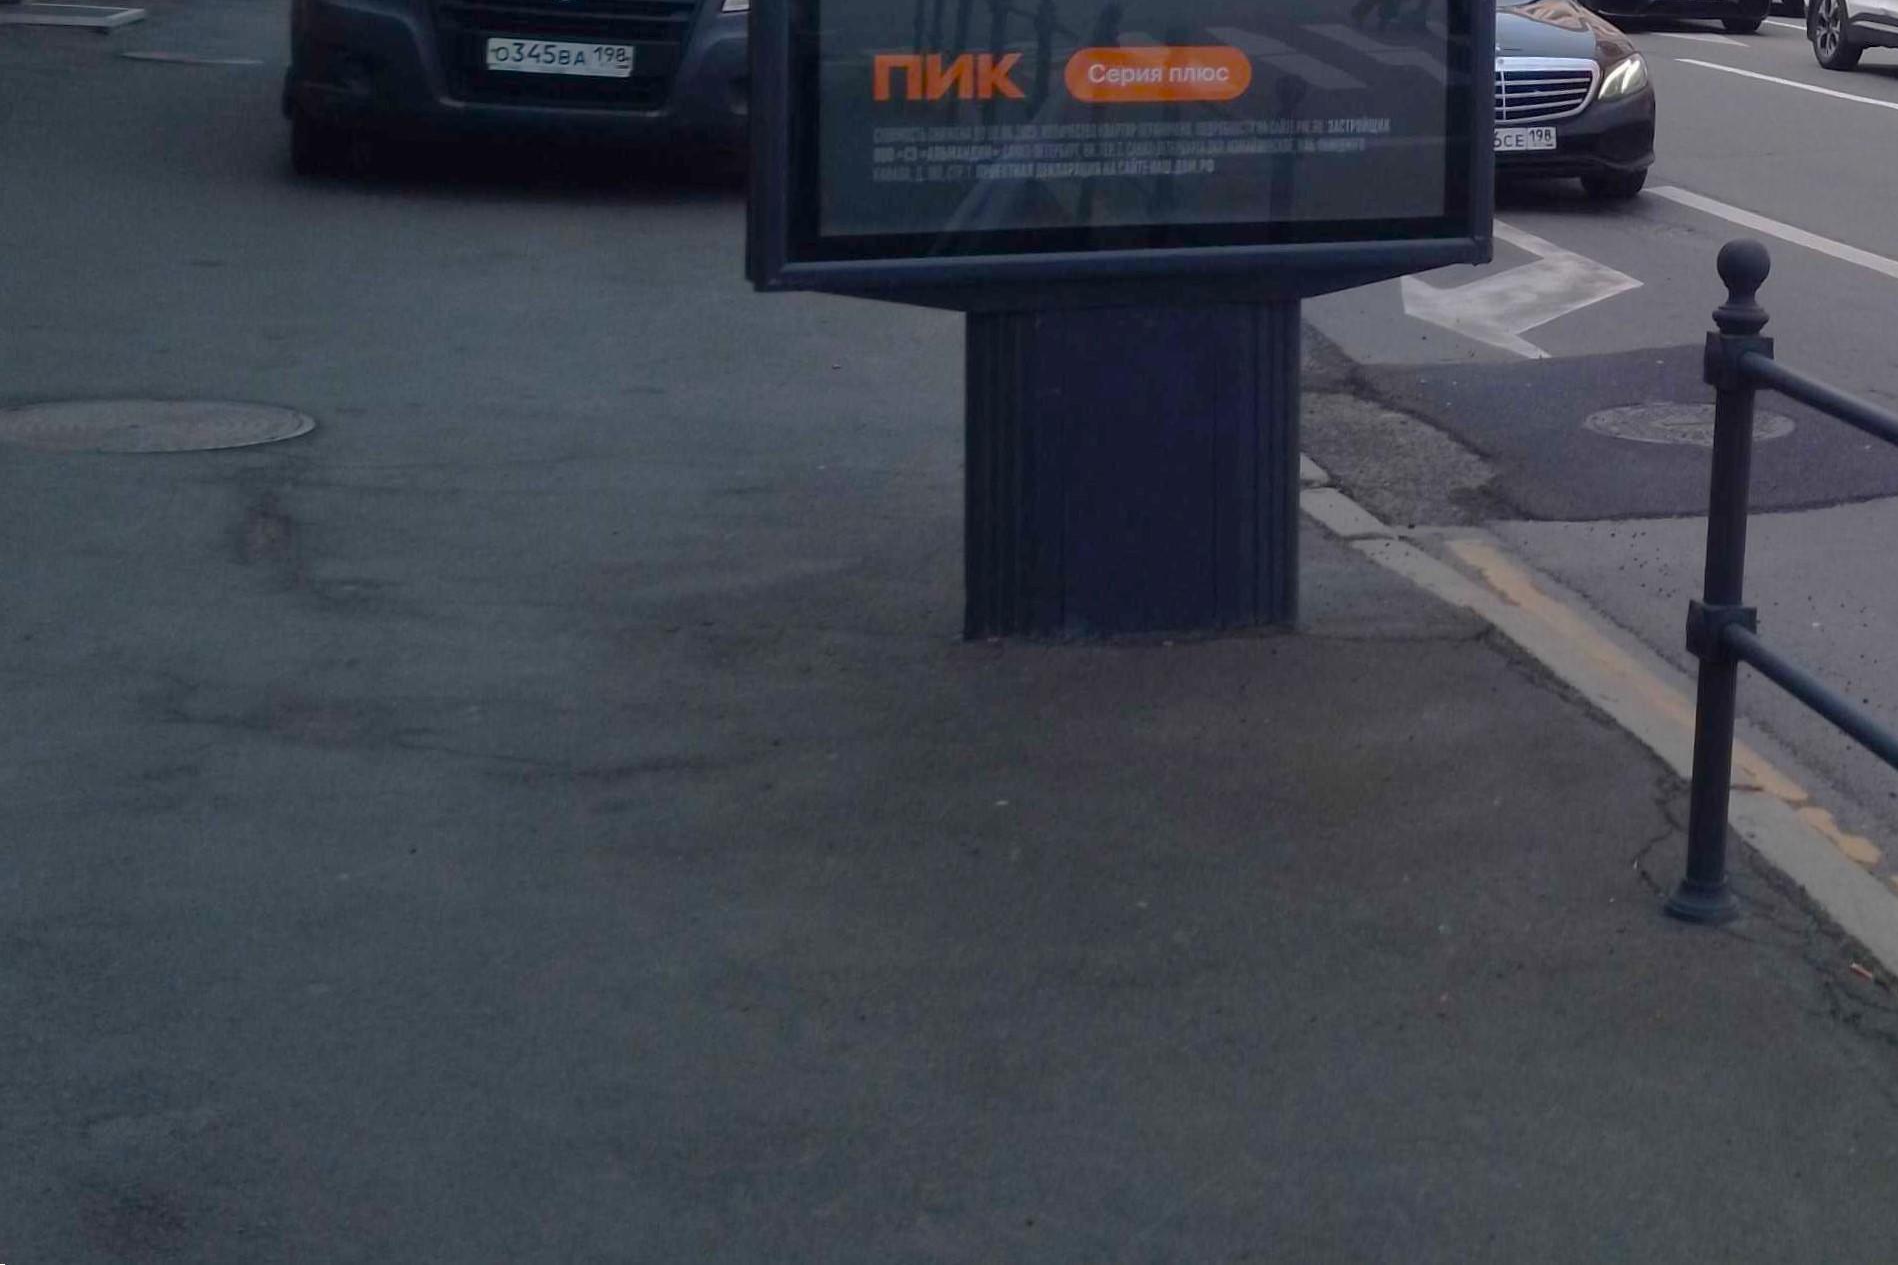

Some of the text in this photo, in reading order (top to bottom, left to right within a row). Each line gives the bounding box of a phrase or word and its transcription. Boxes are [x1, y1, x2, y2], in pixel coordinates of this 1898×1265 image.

[873, 53, 1025, 101] ПИК
[1088, 63, 1230, 87] Серия плюс
